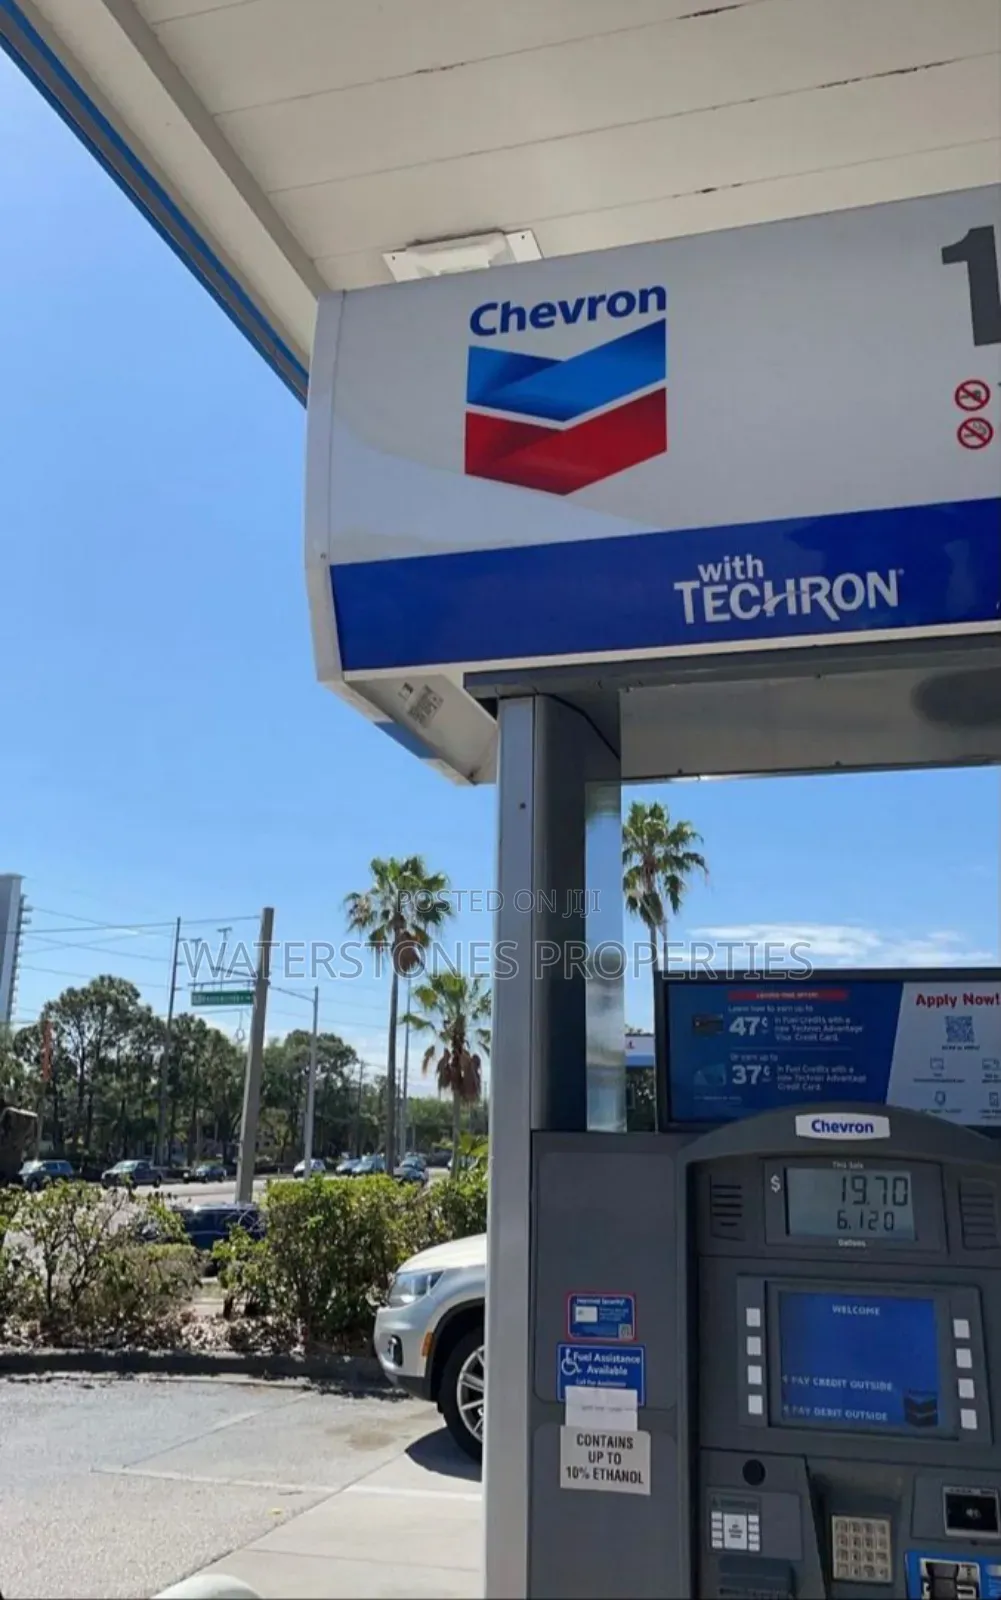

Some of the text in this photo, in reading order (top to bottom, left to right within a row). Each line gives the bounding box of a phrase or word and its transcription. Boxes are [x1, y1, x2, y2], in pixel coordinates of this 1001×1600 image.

[469, 285, 667, 337] Chevron
[698, 554, 764, 582] with
[674, 569, 899, 624] TECHRON
[916, 992, 1001, 1009] Apply Now!
[811, 1118, 875, 1133] Chevron
[770, 1174, 908, 1206] $ 19.70
[837, 1208, 895, 1231] 6.120
[832, 1304, 880, 1316] WELCOME
[573, 1351, 641, 1364] Fuel Assistance
[586, 1365, 628, 1376] Available
[792, 1376, 893, 1392] PAY CREDIT OUTSIDE
[792, 1405, 888, 1421] PAY DEBIT OUTSIDE
[576, 1433, 634, 1449] CONTAINS
[588, 1450, 622, 1465] UP TO
[566, 1466, 644, 1484] 10% ETHANOL
